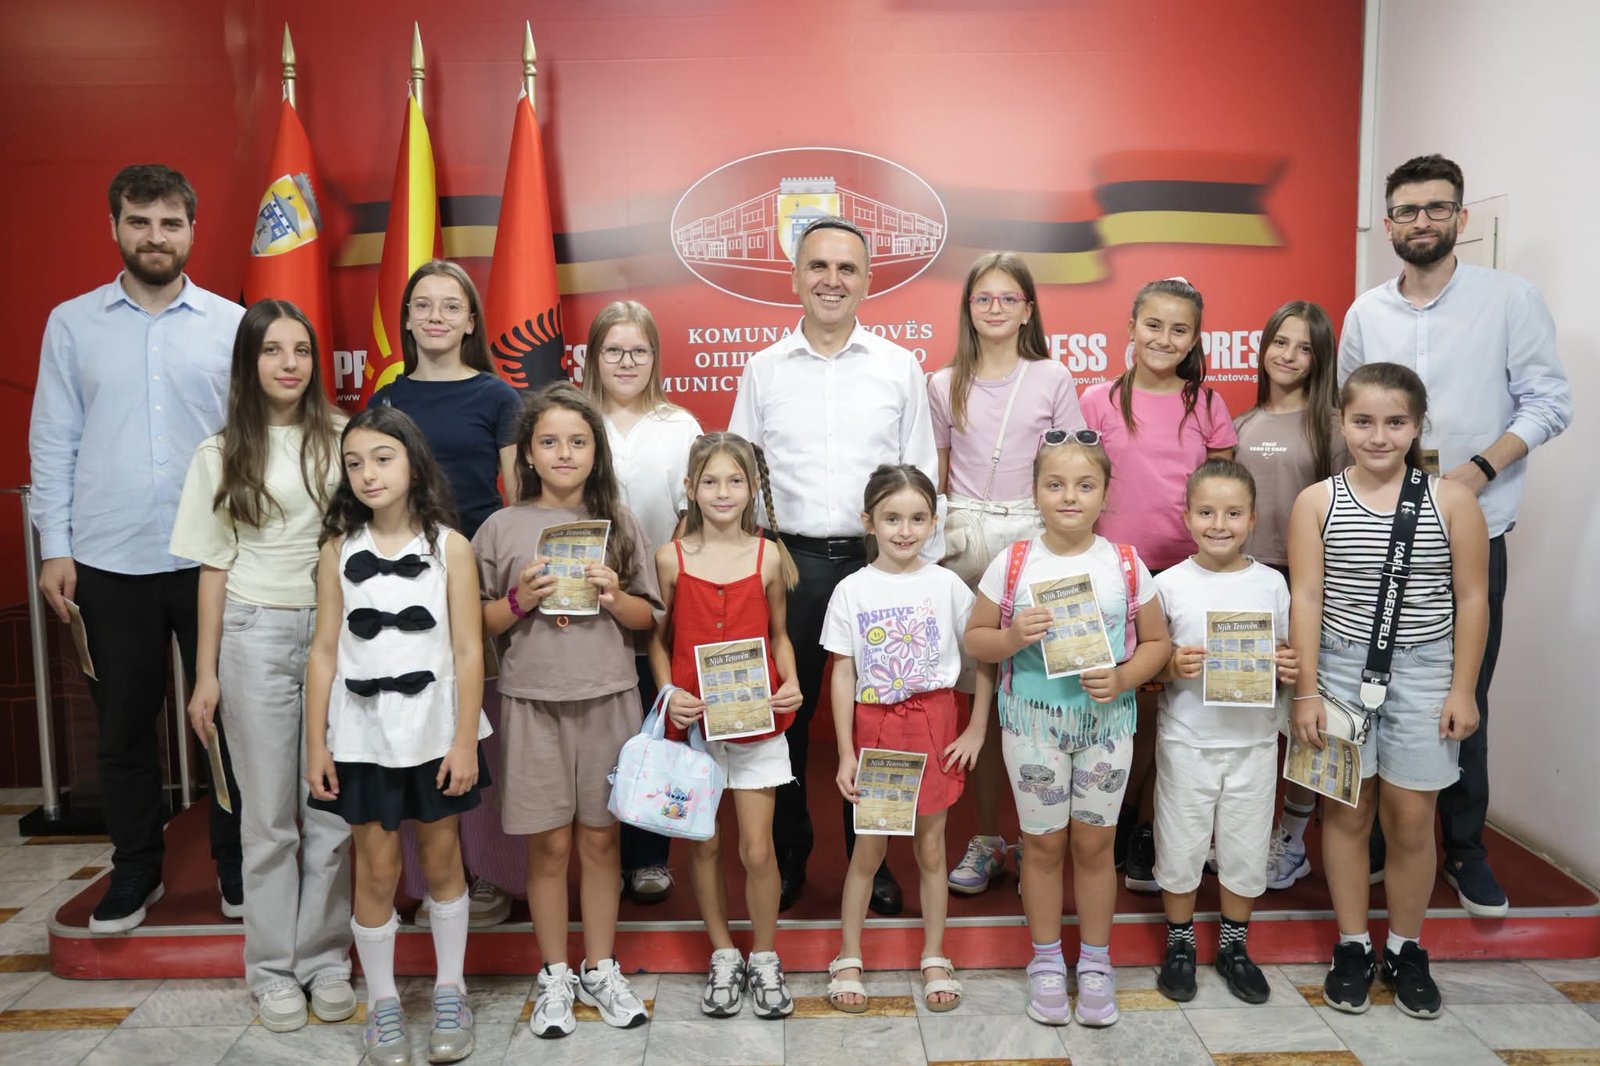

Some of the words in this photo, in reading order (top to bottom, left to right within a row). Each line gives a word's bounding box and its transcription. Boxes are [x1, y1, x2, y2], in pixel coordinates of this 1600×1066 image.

[688, 326, 793, 344] KOMUNA
[1044, 333, 1108, 372] ESS
[1391, 541, 1406, 573] KARL
[857, 606, 915, 635] POSITIVE
